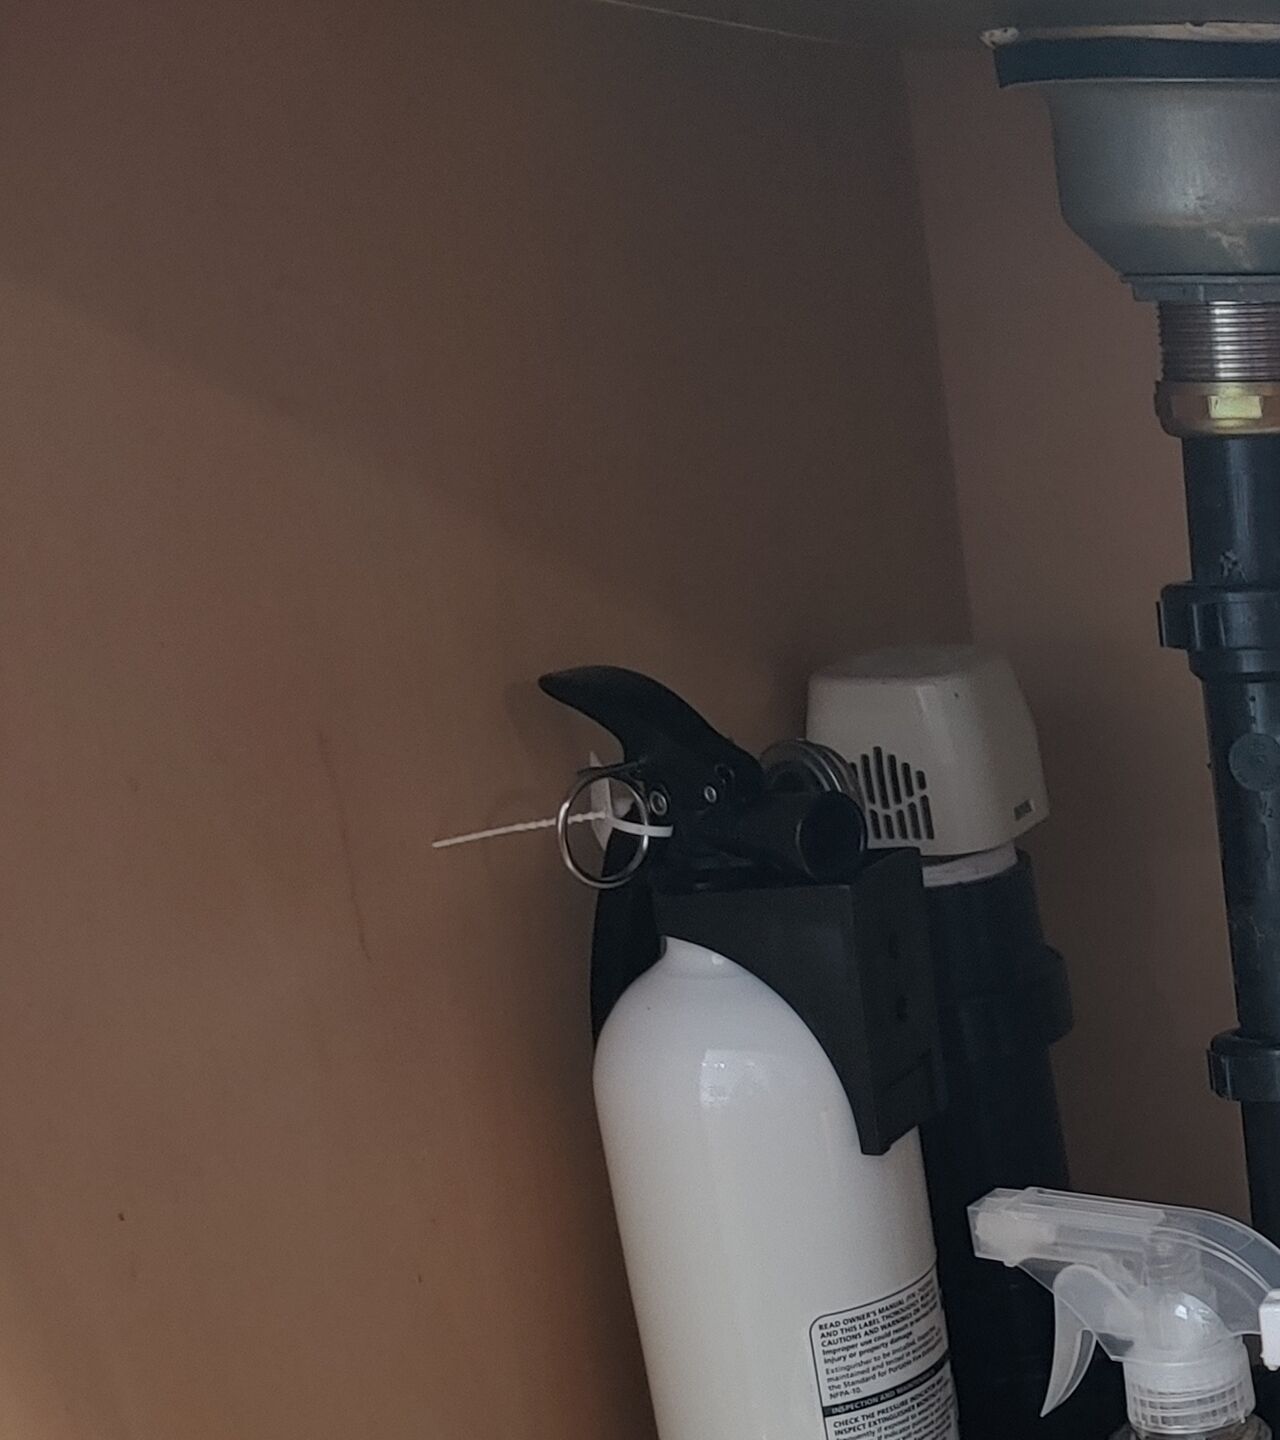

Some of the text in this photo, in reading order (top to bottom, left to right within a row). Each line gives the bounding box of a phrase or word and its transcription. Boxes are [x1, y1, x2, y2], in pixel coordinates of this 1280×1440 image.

[819, 1320, 841, 1331] READ
[842, 1310, 878, 1328] OWNER'S
[820, 1329, 839, 1339] AND
[840, 1324, 858, 1335] THIS
[821, 1327, 880, 1348] CAUTIONS AND
[833, 1416, 859, 1429] CHECK
[860, 1412, 876, 1422] THE
[834, 1424, 867, 1437] INSPECT
